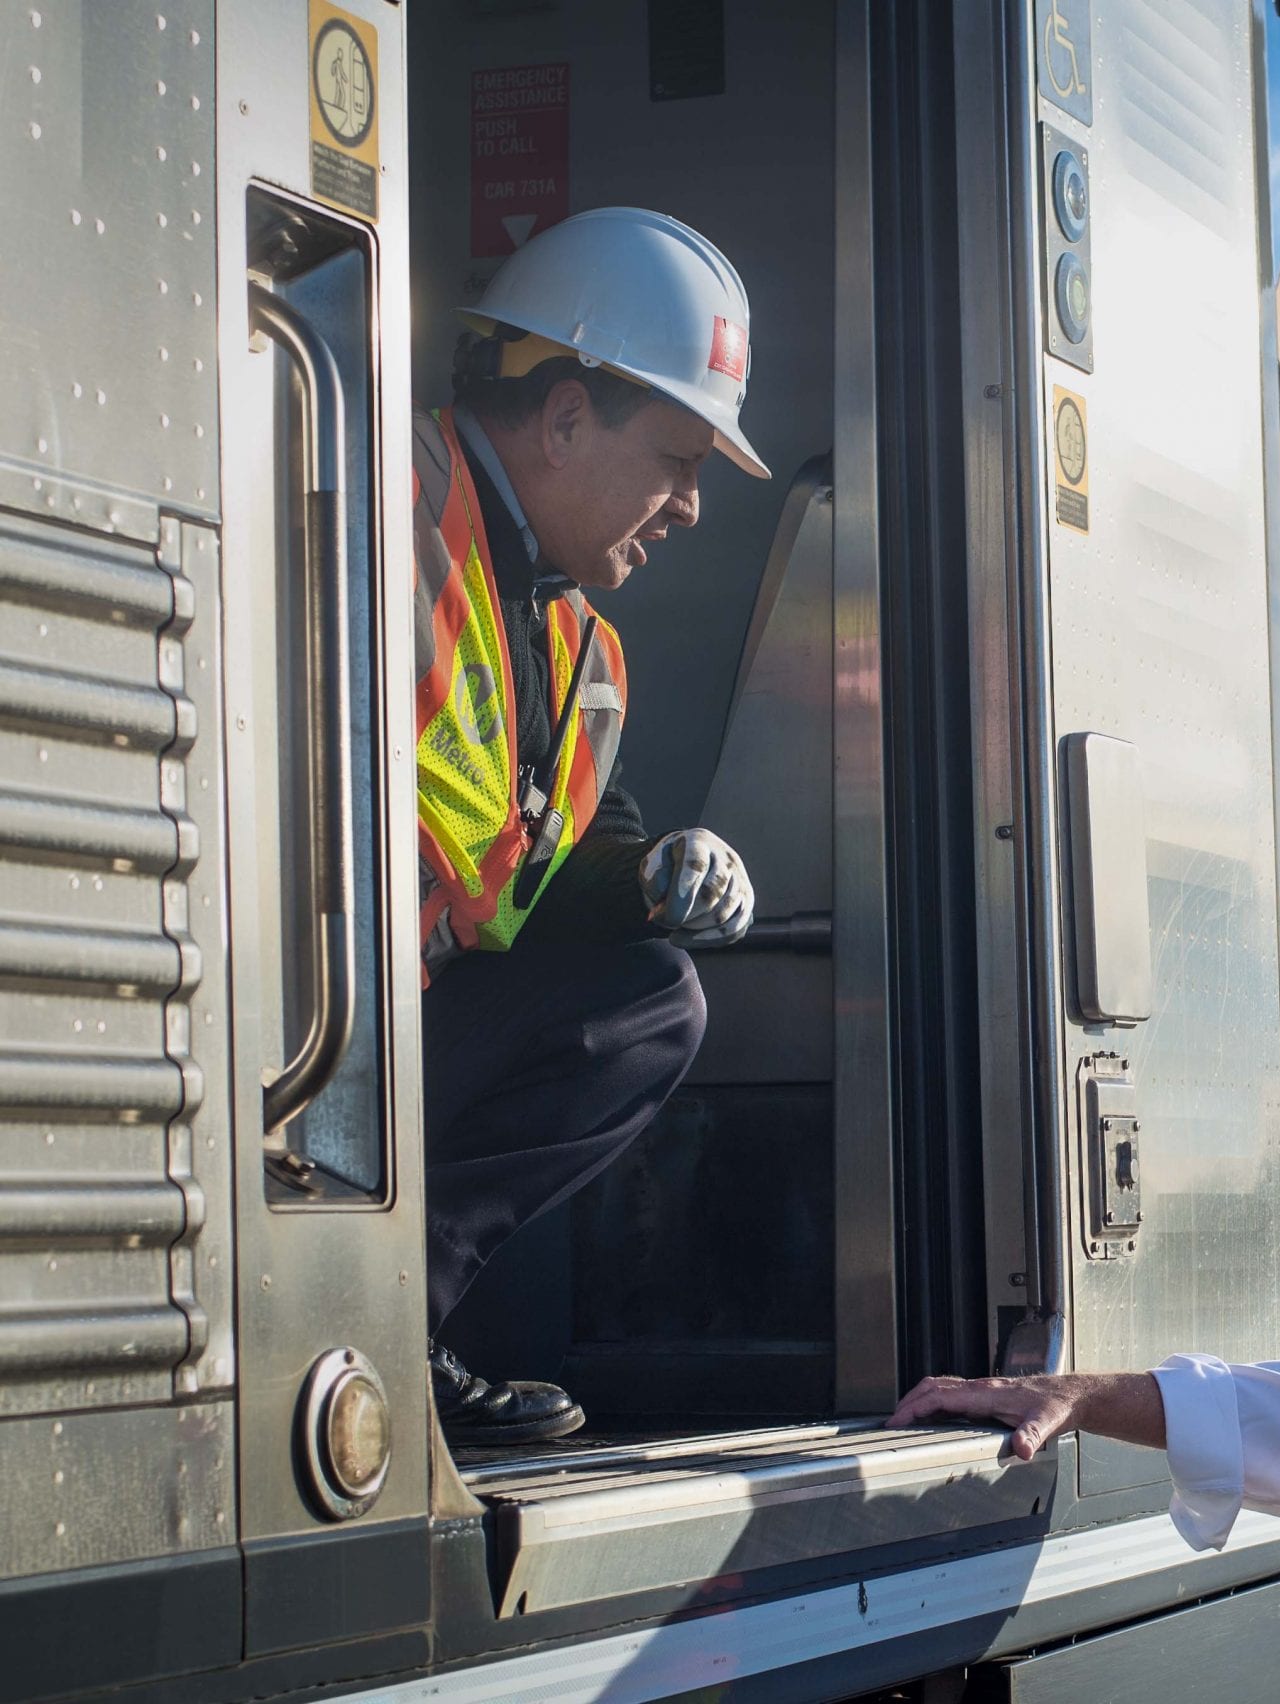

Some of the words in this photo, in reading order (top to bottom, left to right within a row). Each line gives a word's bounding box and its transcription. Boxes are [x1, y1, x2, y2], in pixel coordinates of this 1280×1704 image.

[474, 66, 567, 91] EMERGENCY
[474, 86, 567, 110] ASSISTANCE
[475, 118, 518, 137] PUSH
[474, 139, 495, 157] TO
[498, 136, 538, 155] CALL
[484, 180, 516, 199] CAR
[520, 178, 557, 196] 731A
[429, 727, 485, 785] Metro
